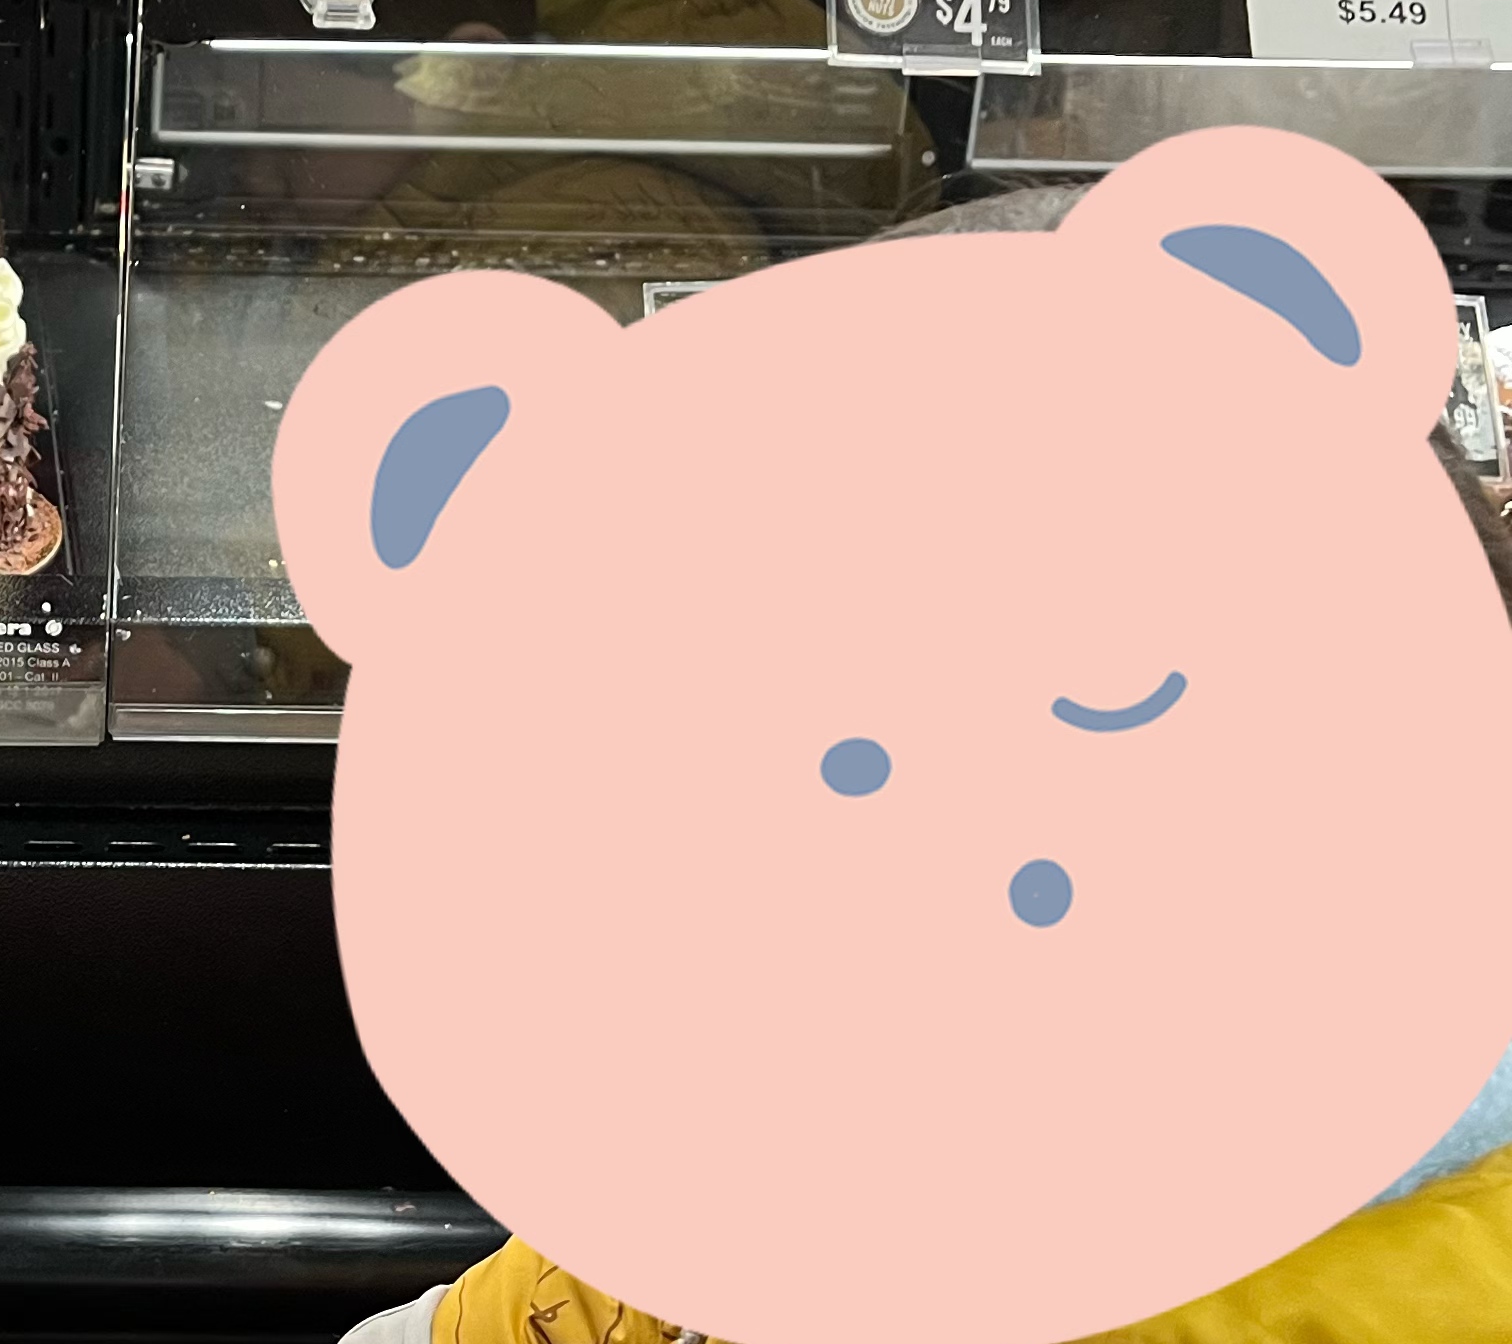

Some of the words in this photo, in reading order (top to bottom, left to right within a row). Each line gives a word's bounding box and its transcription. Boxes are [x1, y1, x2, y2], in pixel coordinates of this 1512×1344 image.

[17, 642, 60, 654] GLASS
[27, 657, 59, 668] Class
[62, 658, 70, 667] A
